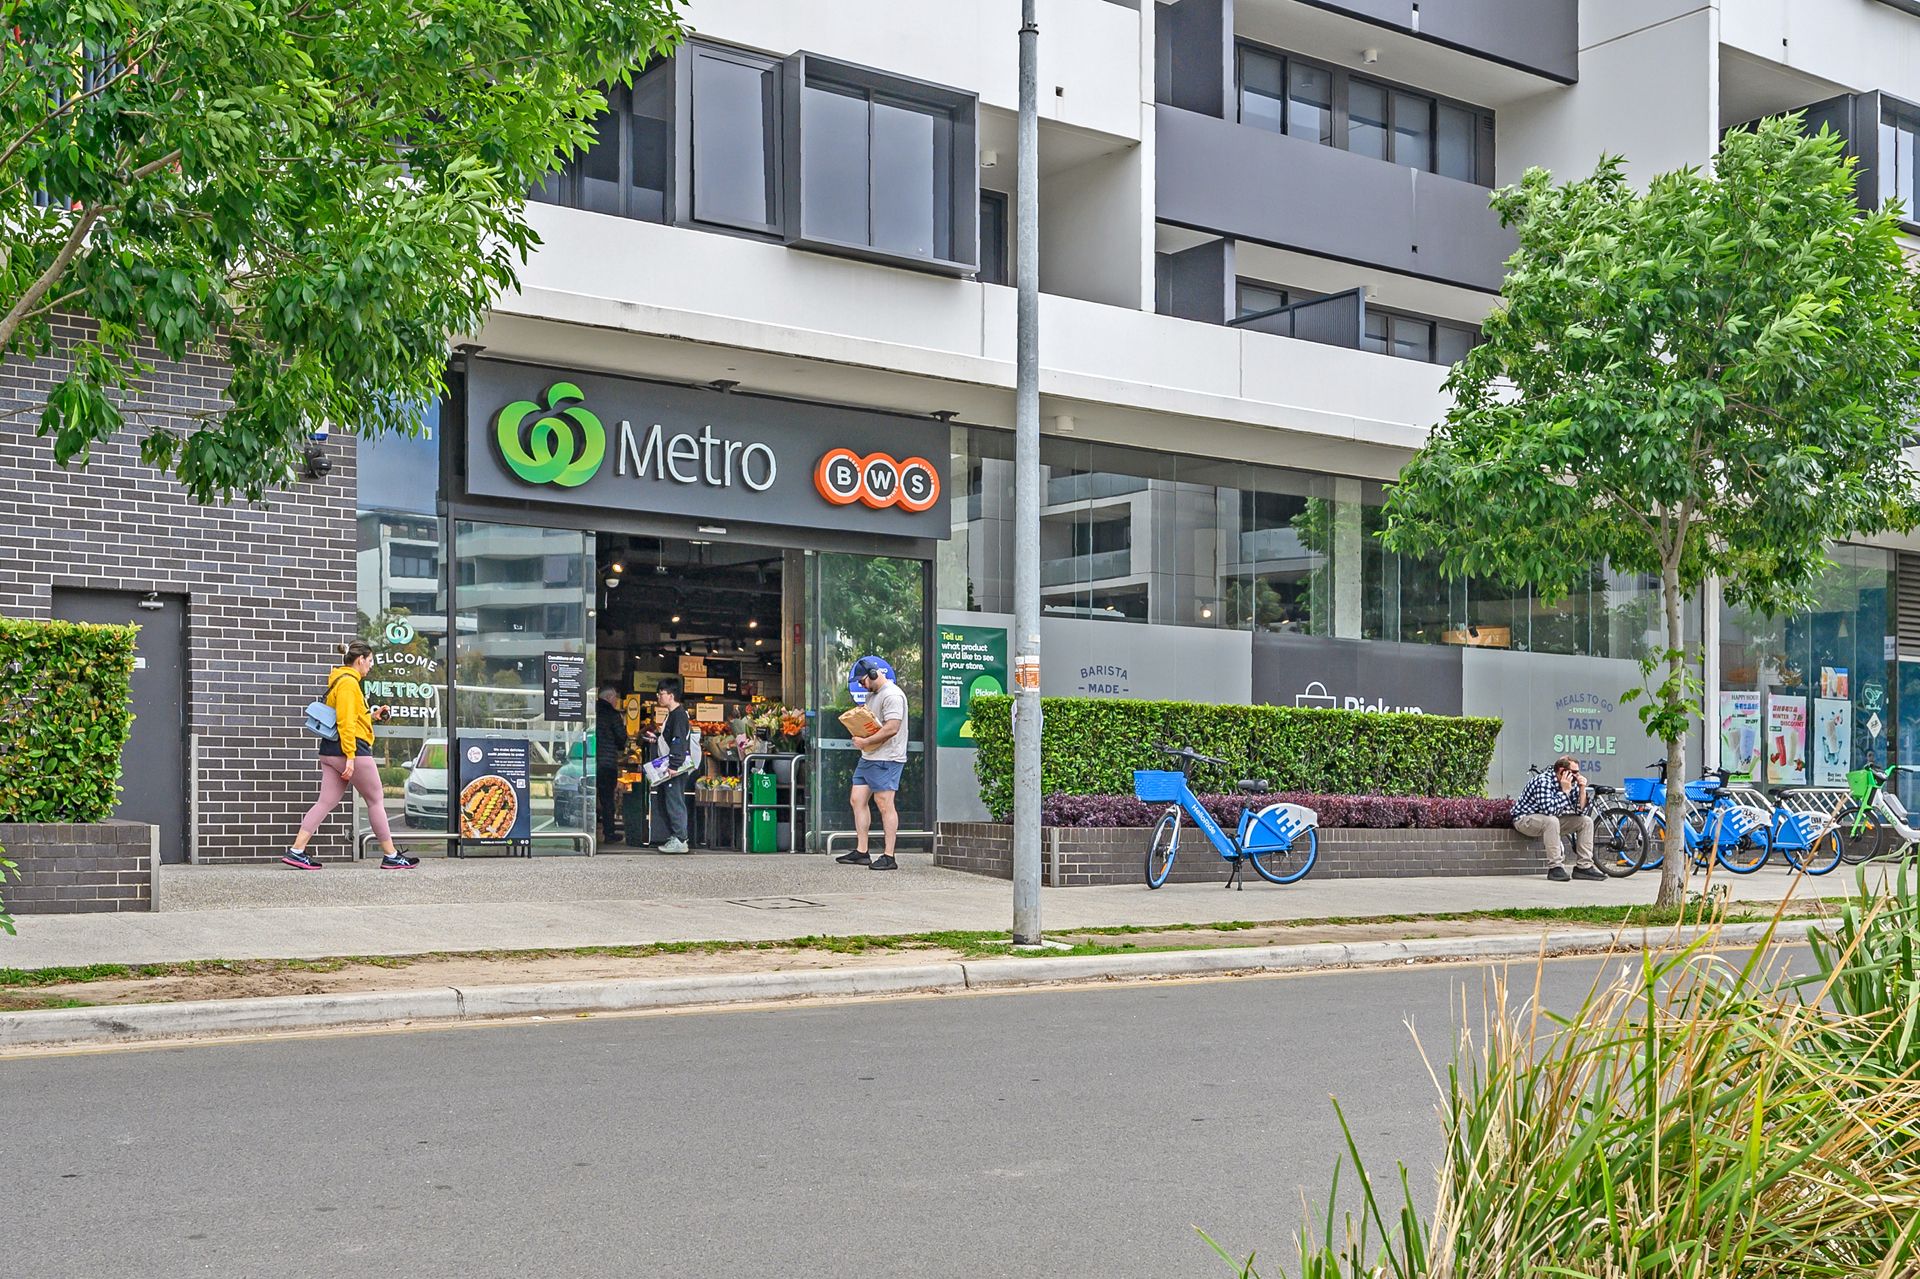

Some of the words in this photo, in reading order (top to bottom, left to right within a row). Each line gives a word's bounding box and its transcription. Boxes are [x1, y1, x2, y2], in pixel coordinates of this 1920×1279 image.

[618, 420, 777, 491] Metro
[837, 465, 924, 494] BWS
[941, 632, 954, 641] Tell
[941, 643, 960, 651] what
[961, 643, 988, 652] product
[373, 652, 438, 672] ELCOME
[941, 652, 960, 661] you'd
[962, 652, 973, 661] like
[974, 653, 982, 661] to
[941, 660, 948, 668] in
[949, 662, 964, 671] your
[965, 662, 985, 670] store.
[1080, 665, 1128, 680] BARISTA
[364, 680, 434, 699] METRO
[1088, 683, 1119, 694] MADE
[1555, 692, 1585, 710] MEALS
[1587, 693, 1599, 705] TO
[1600, 699, 1614, 713] GO
[1567, 717, 1603, 731] TASTY
[1553, 734, 1616, 755] SIMPLE
[1580, 760, 1602, 772] EAS
[1191, 804, 1216, 835] HelloRide
